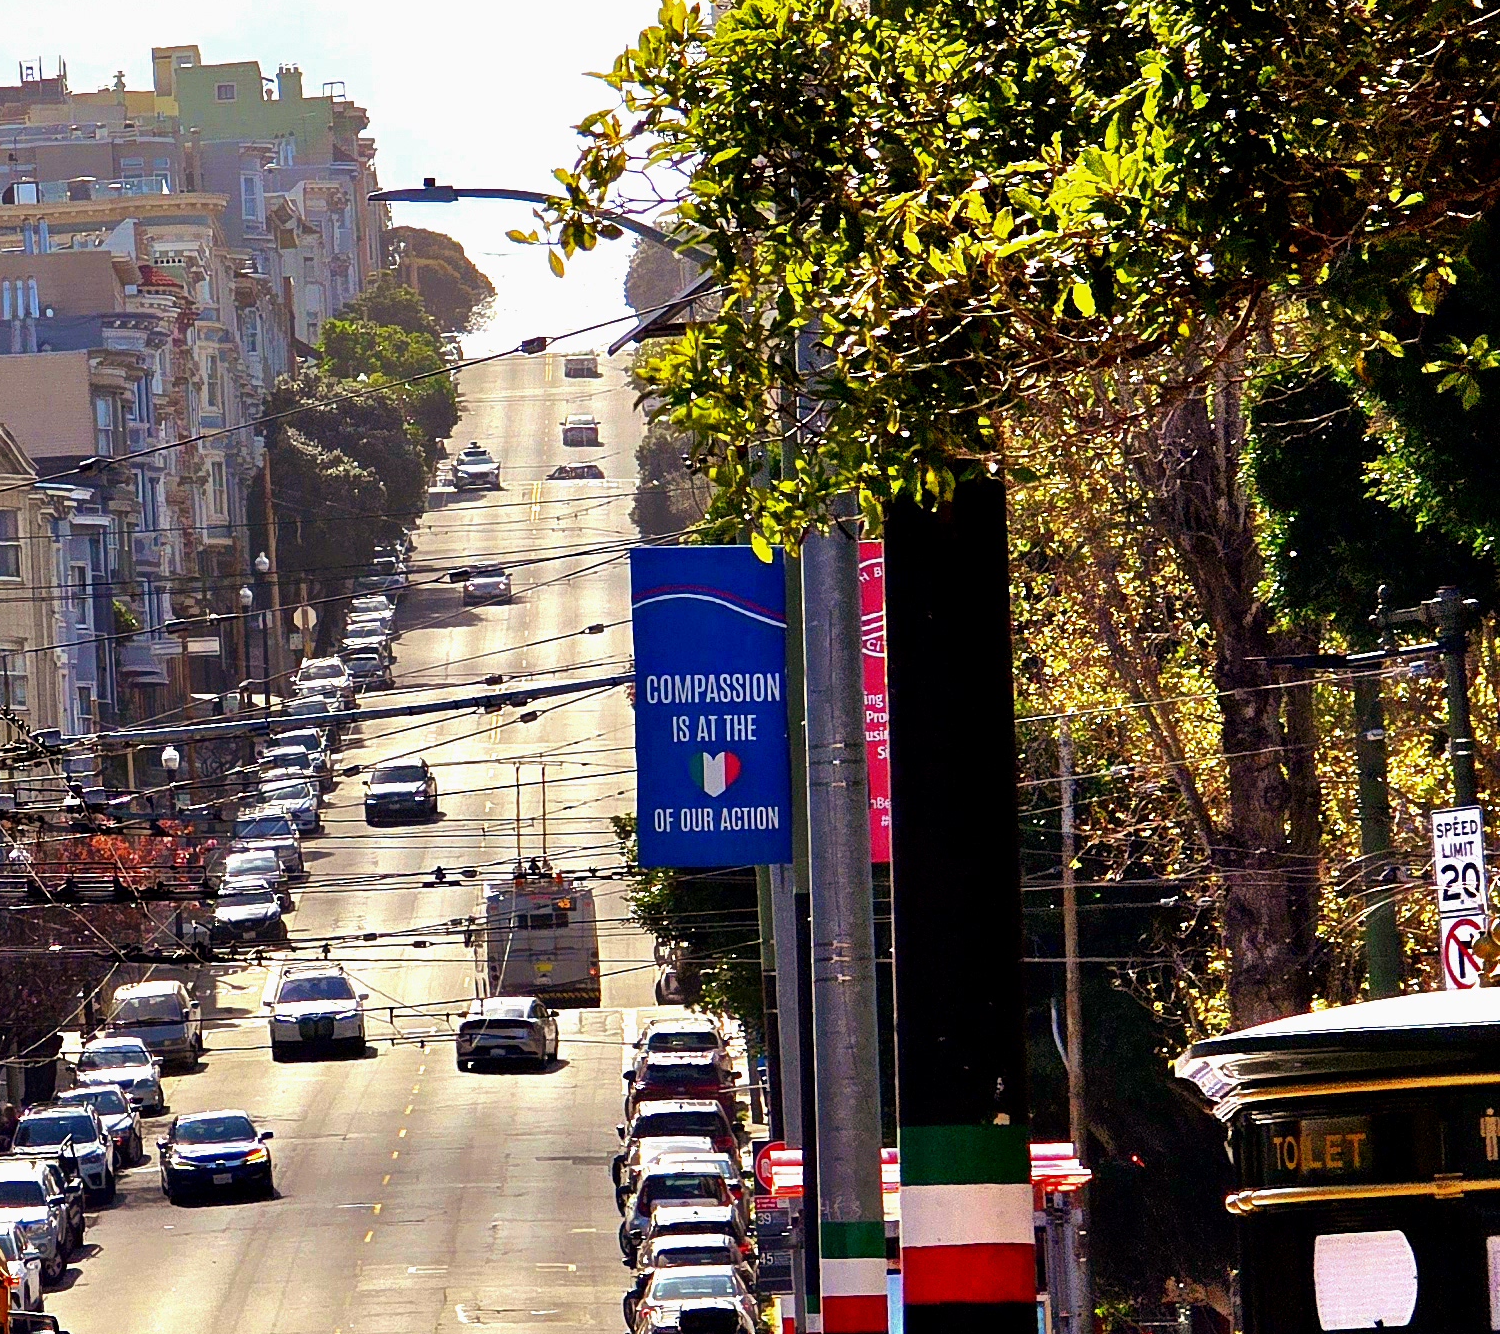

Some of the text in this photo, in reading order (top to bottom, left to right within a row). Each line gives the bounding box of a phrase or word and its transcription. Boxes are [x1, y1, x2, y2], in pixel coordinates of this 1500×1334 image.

[646, 672, 780, 704] COMPASSION
[672, 714, 757, 743] IS AT THE
[654, 806, 779, 832] OF OUR ACTION
[1436, 820, 1478, 838] SPEED
[1441, 841, 1475, 858] LIMIT
[1441, 862, 1481, 901] 20
[757, 1212, 772, 1225] 39
[759, 1252, 774, 1265] 45
